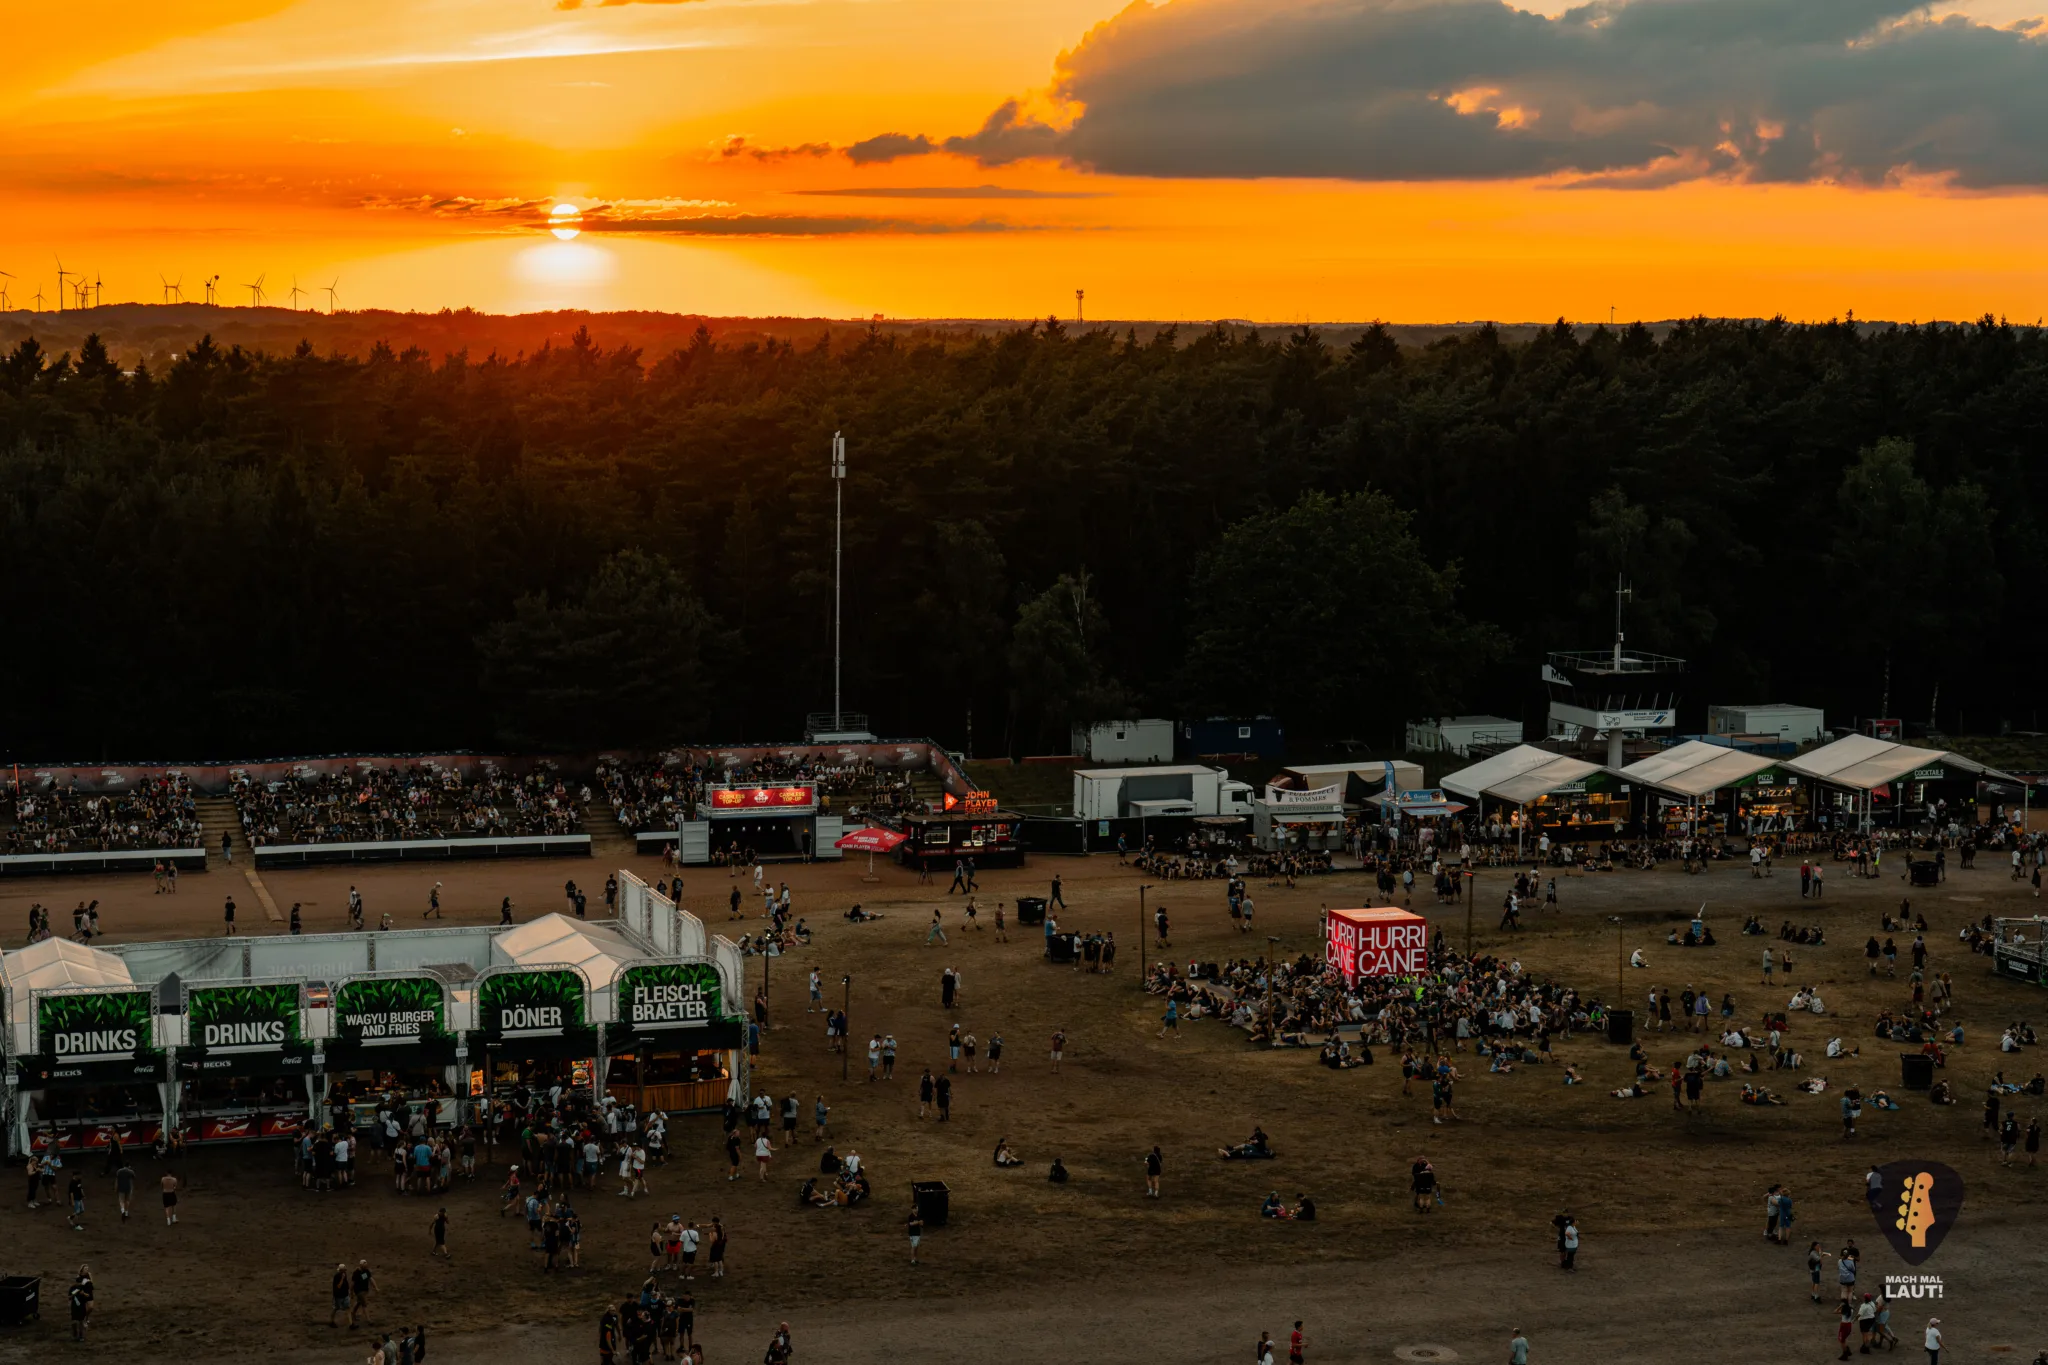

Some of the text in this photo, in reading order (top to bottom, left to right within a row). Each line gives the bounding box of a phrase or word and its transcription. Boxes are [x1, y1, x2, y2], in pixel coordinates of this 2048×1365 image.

[1914, 769, 1944, 777] COCKTAILS
[965, 790, 990, 799] JOHN
[965, 799, 998, 807] PLAYER
[1295, 795, 1327, 803] POMMES
[1326, 917, 1355, 950] HURRI
[1358, 925, 1426, 950] HURRI
[1326, 941, 1355, 973] CANE
[1358, 948, 1426, 975] CANE
[634, 984, 708, 1004] FLEISCH-
[345, 1010, 435, 1026] WAGYU BURGER
[501, 1004, 562, 1029] DÖNER
[632, 1001, 707, 1022] BRAETER
[205, 1020, 285, 1046] DRINKS
[361, 1023, 420, 1037] AND FRIES
[54, 1028, 137, 1055] DRINKS
[53, 1069, 83, 1078] BECK'S
[203, 1060, 232, 1069] BECK'S
